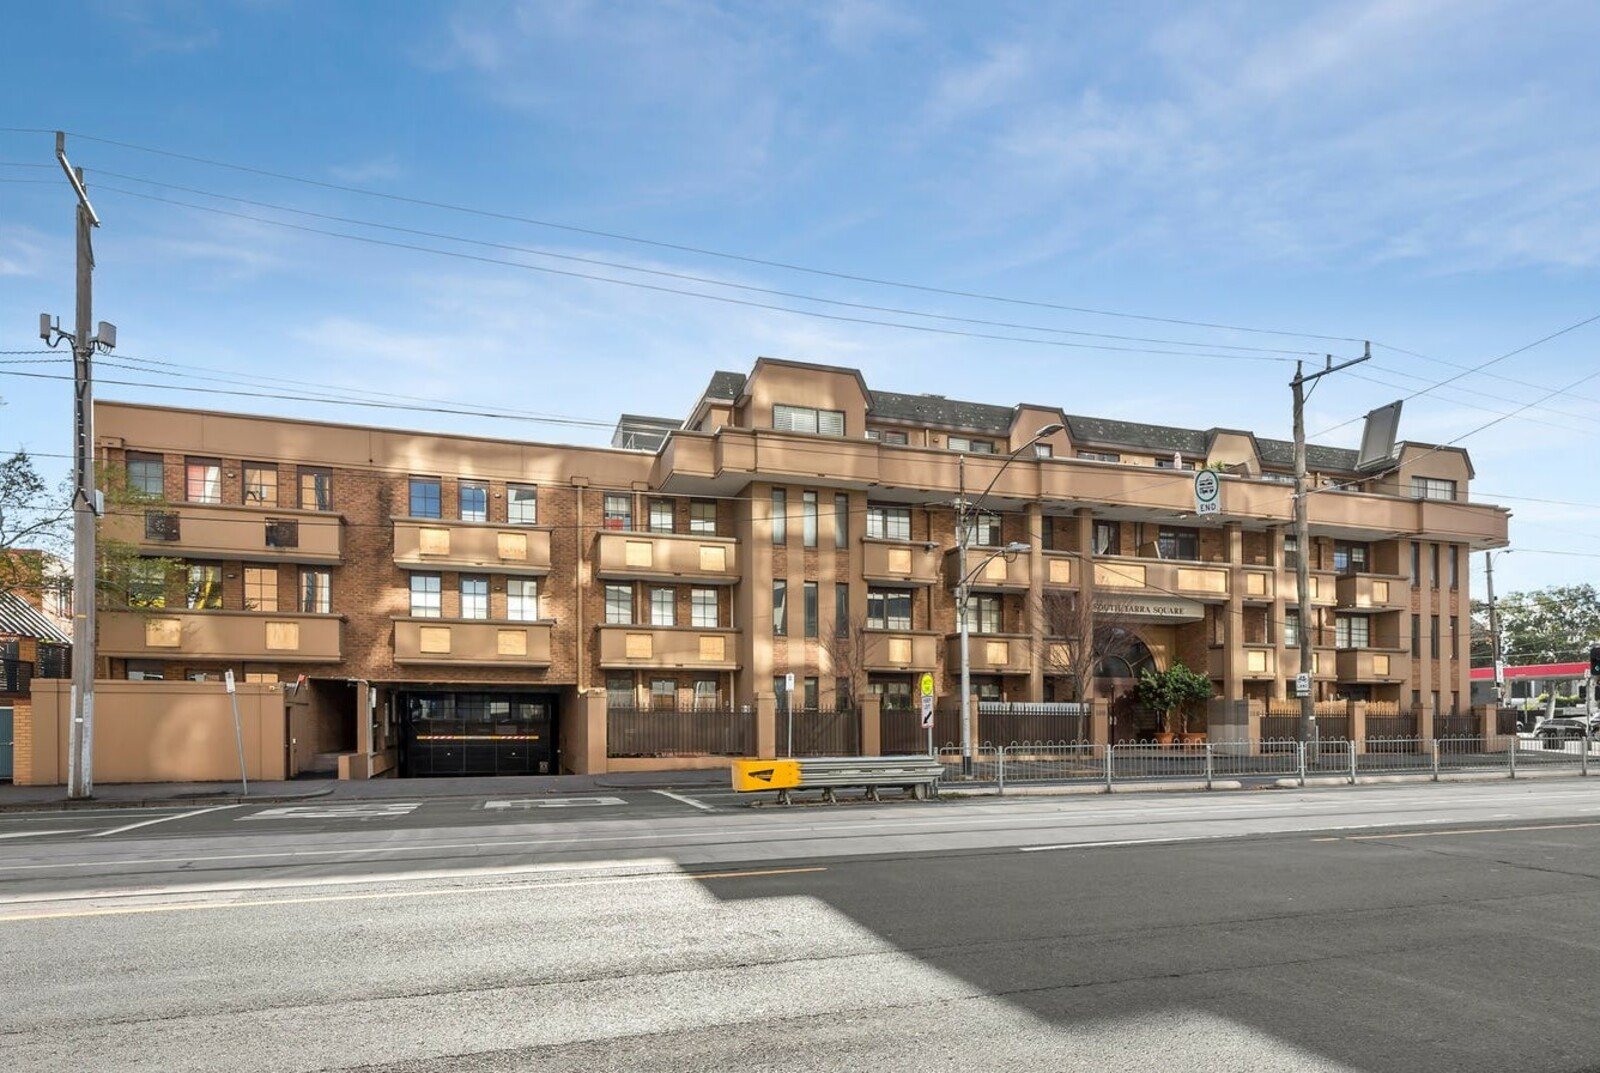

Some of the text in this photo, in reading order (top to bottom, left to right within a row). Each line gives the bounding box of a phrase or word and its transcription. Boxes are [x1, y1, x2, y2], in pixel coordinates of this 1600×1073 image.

[1200, 503, 1216, 512] END
[1093, 603, 1185, 615] SOUTH YARRA SQUARE
